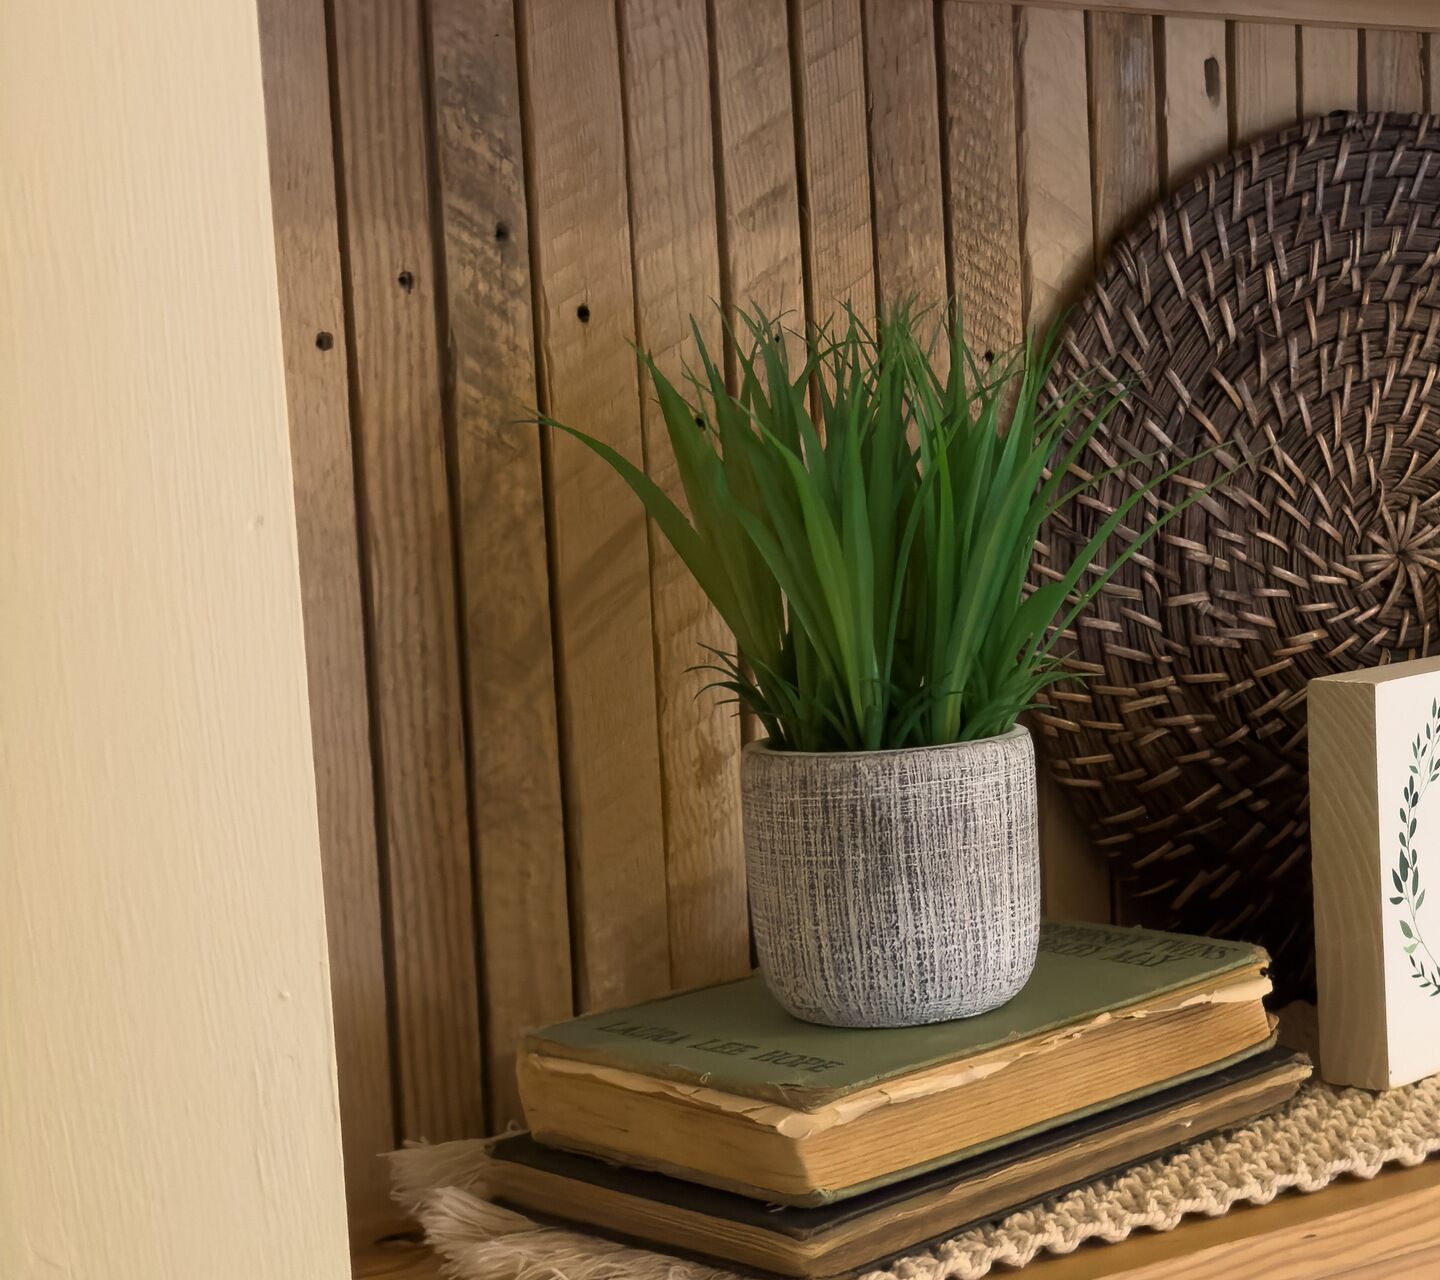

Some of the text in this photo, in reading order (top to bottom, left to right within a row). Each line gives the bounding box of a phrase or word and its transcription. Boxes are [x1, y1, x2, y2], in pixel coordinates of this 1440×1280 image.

[596, 1021, 845, 1073] LAURA LEE HOPE
